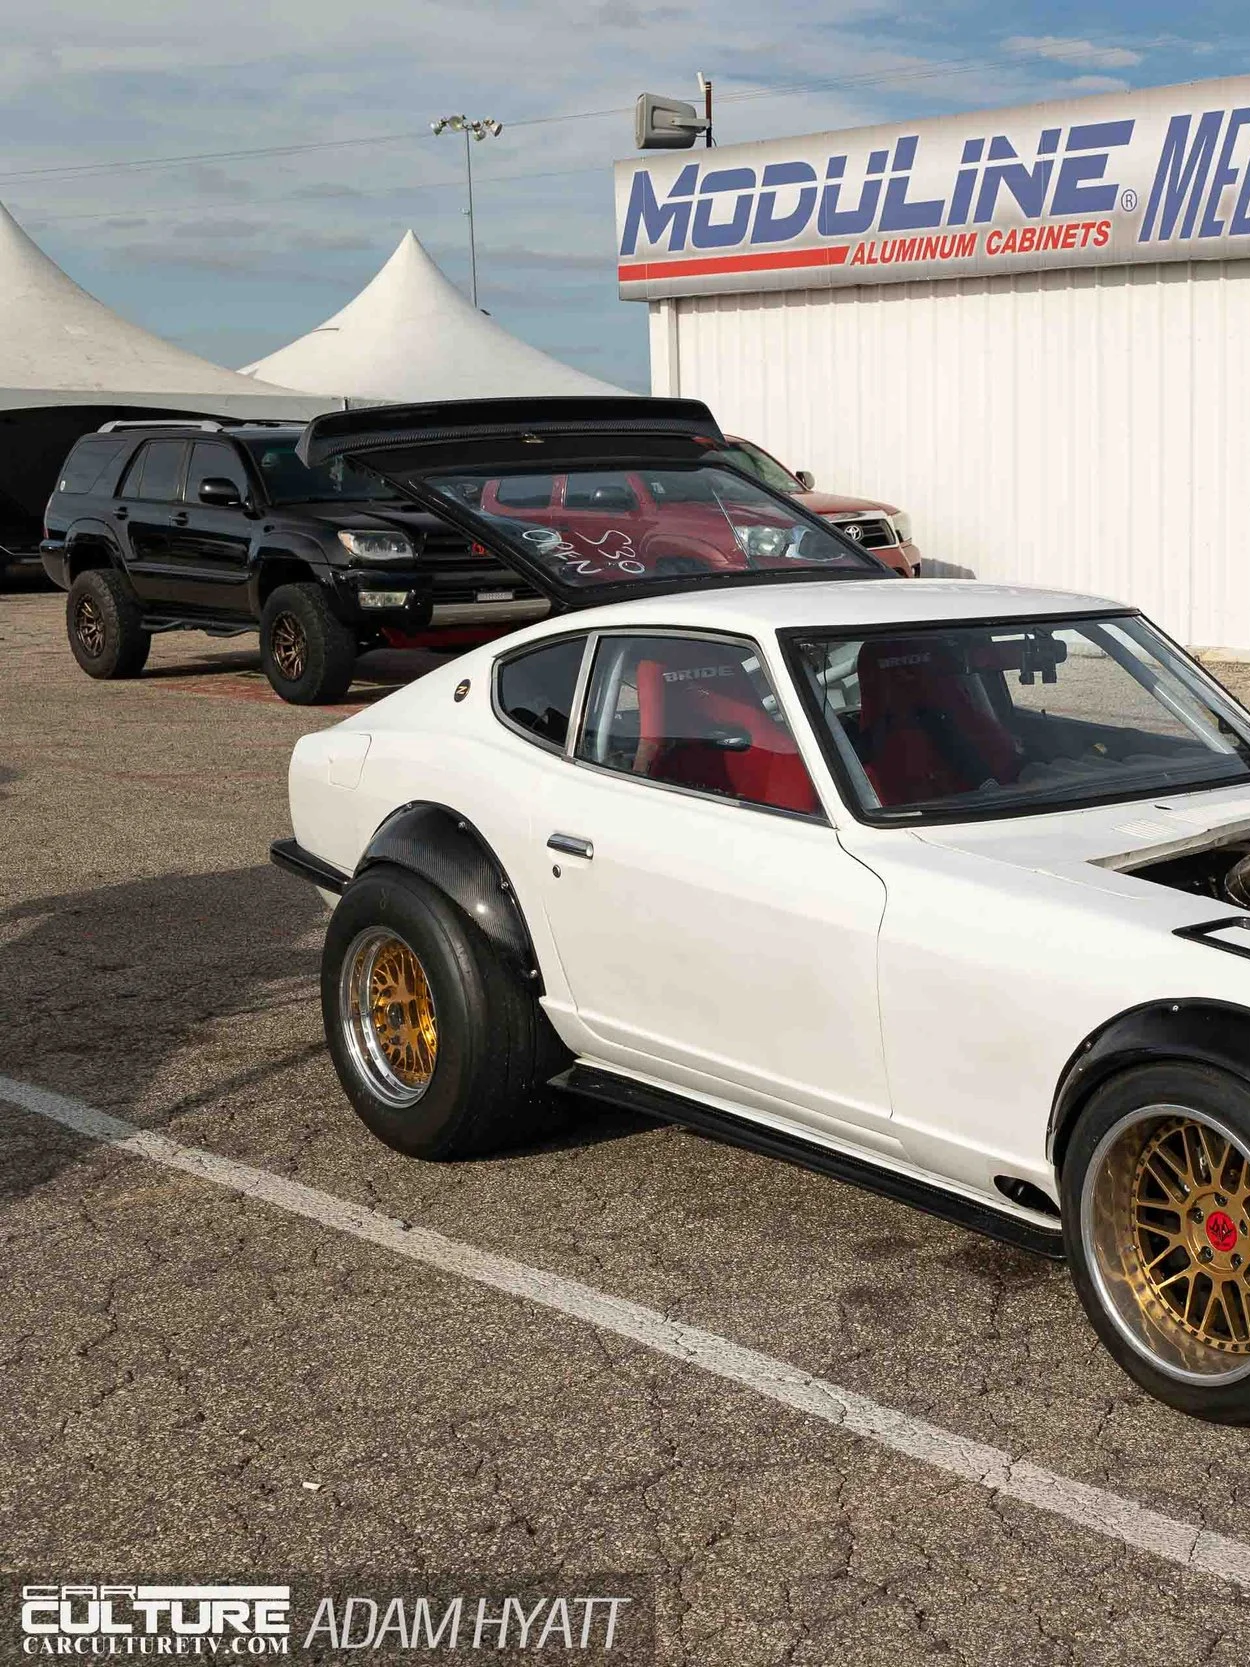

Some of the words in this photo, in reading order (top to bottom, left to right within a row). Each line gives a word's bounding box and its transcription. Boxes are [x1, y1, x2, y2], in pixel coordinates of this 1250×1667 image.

[850, 233, 977, 265] ALUMINUM
[986, 221, 1111, 255] CABINETS
[663, 664, 735, 682] BRIDE
